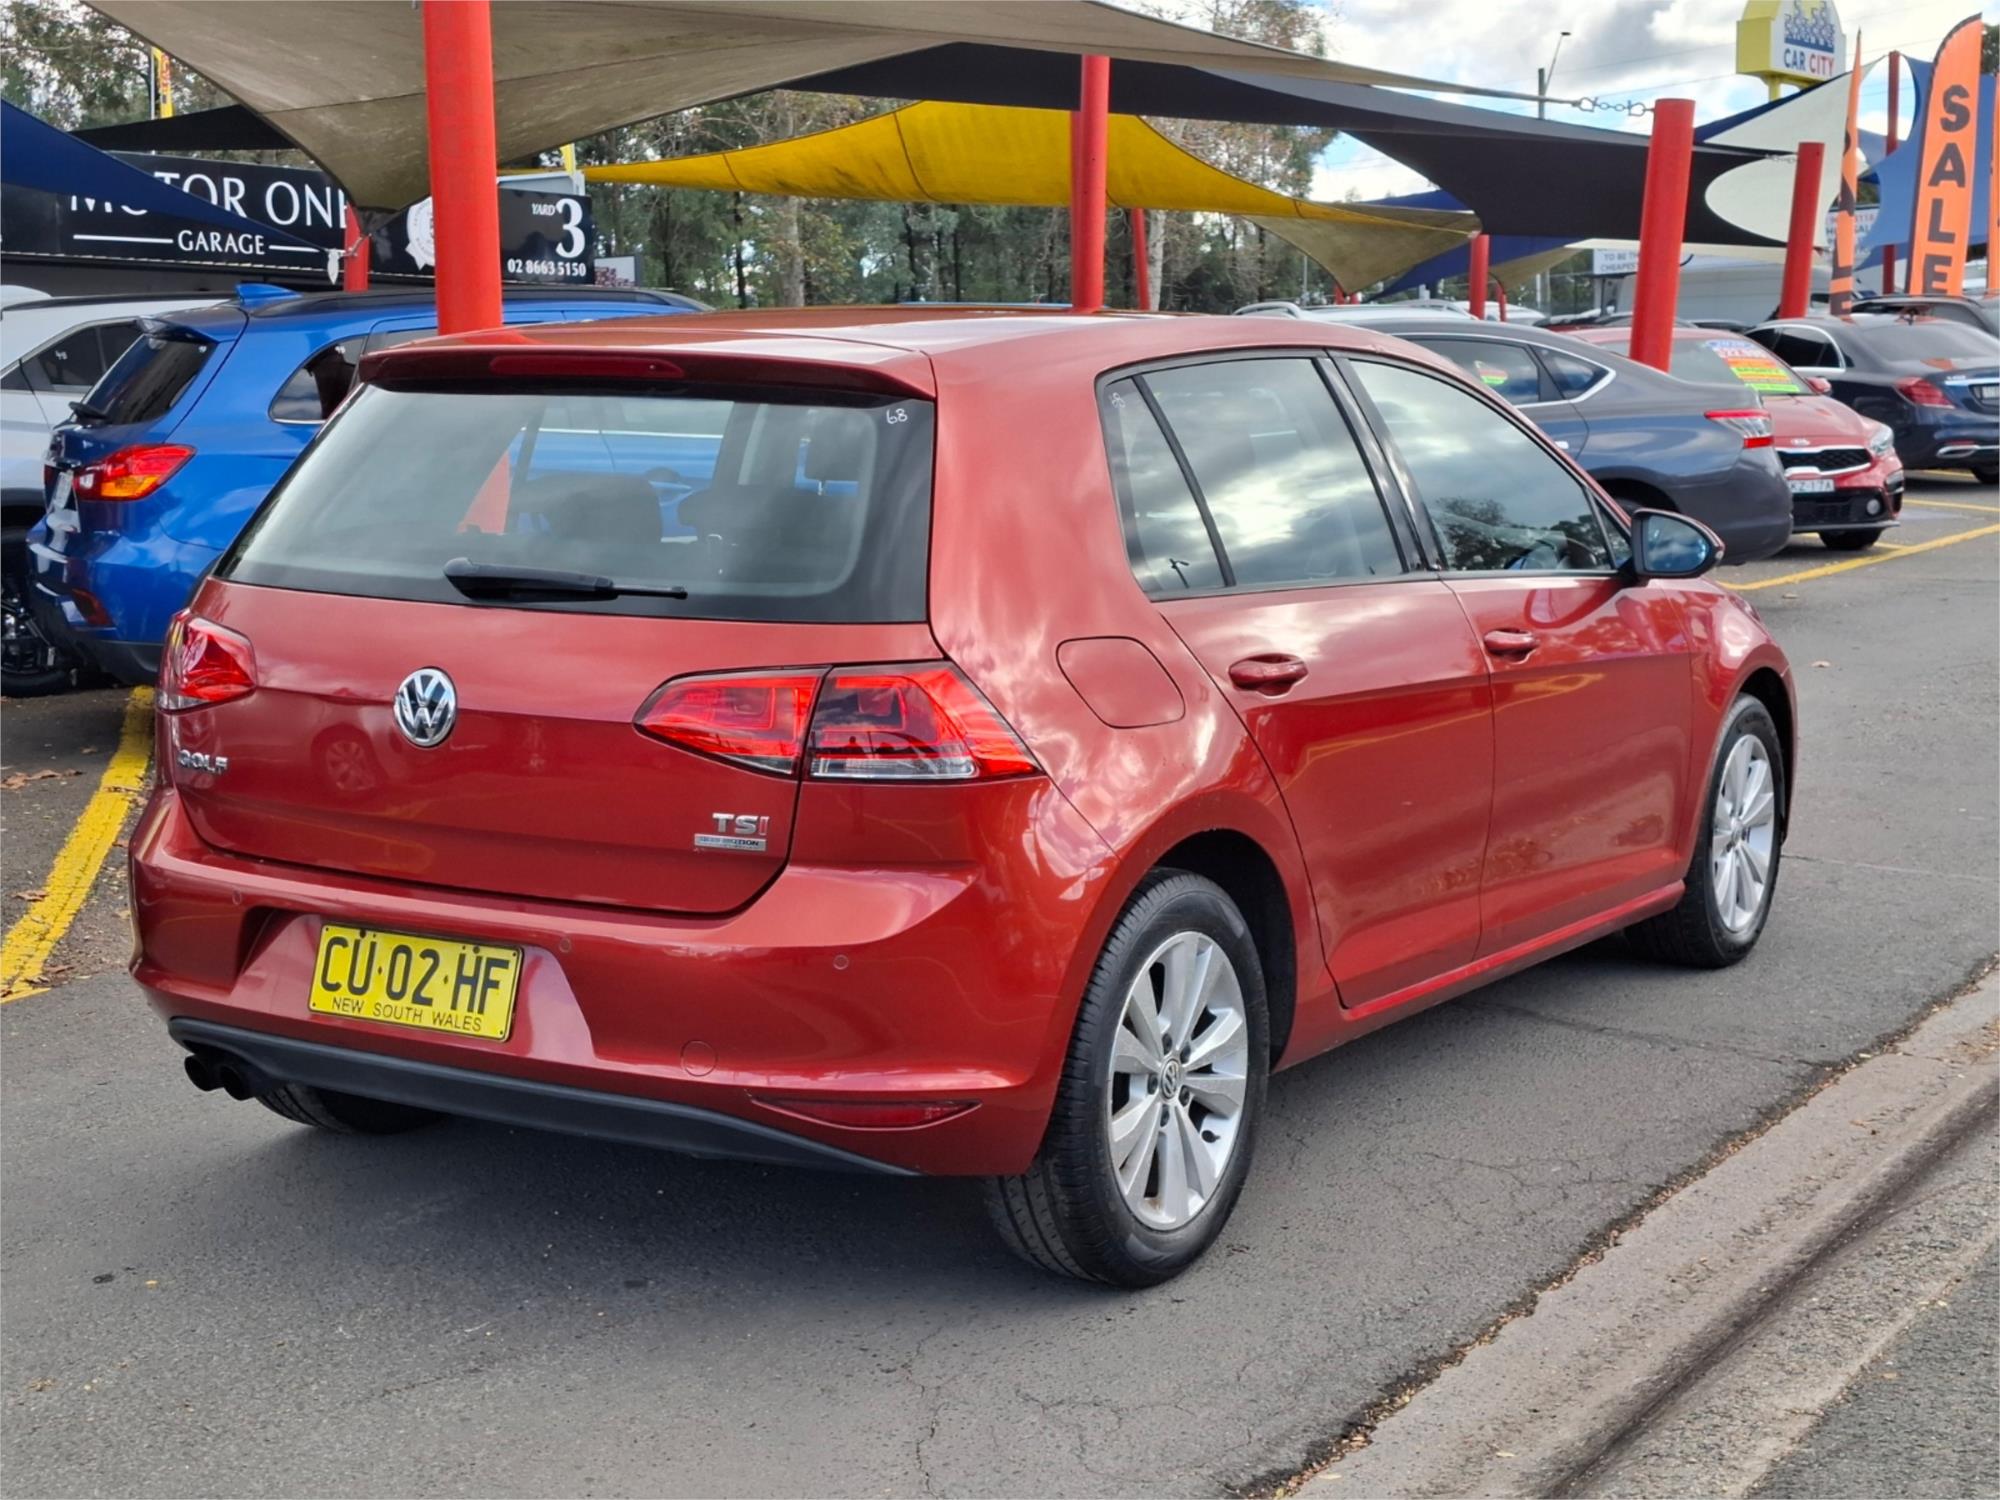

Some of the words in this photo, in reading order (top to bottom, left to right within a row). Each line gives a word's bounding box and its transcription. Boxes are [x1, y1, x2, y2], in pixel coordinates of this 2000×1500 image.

[1784, 48, 1806, 72] CAR
[1809, 53, 1835, 77] CITY
[1925, 84, 1972, 295] SALE
[177, 229, 265, 255] GARAGE
[532, 203, 556, 217] YARD
[555, 198, 586, 259] 3
[507, 258, 523, 274] 02
[525, 260, 555, 276] 8663
[557, 262, 587, 277] 5150
[886, 408, 908, 424] 68
[331, 997, 365, 1015] NEW
[372, 1001, 424, 1021] SOUTH
[432, 1012, 483, 1033] WALES
